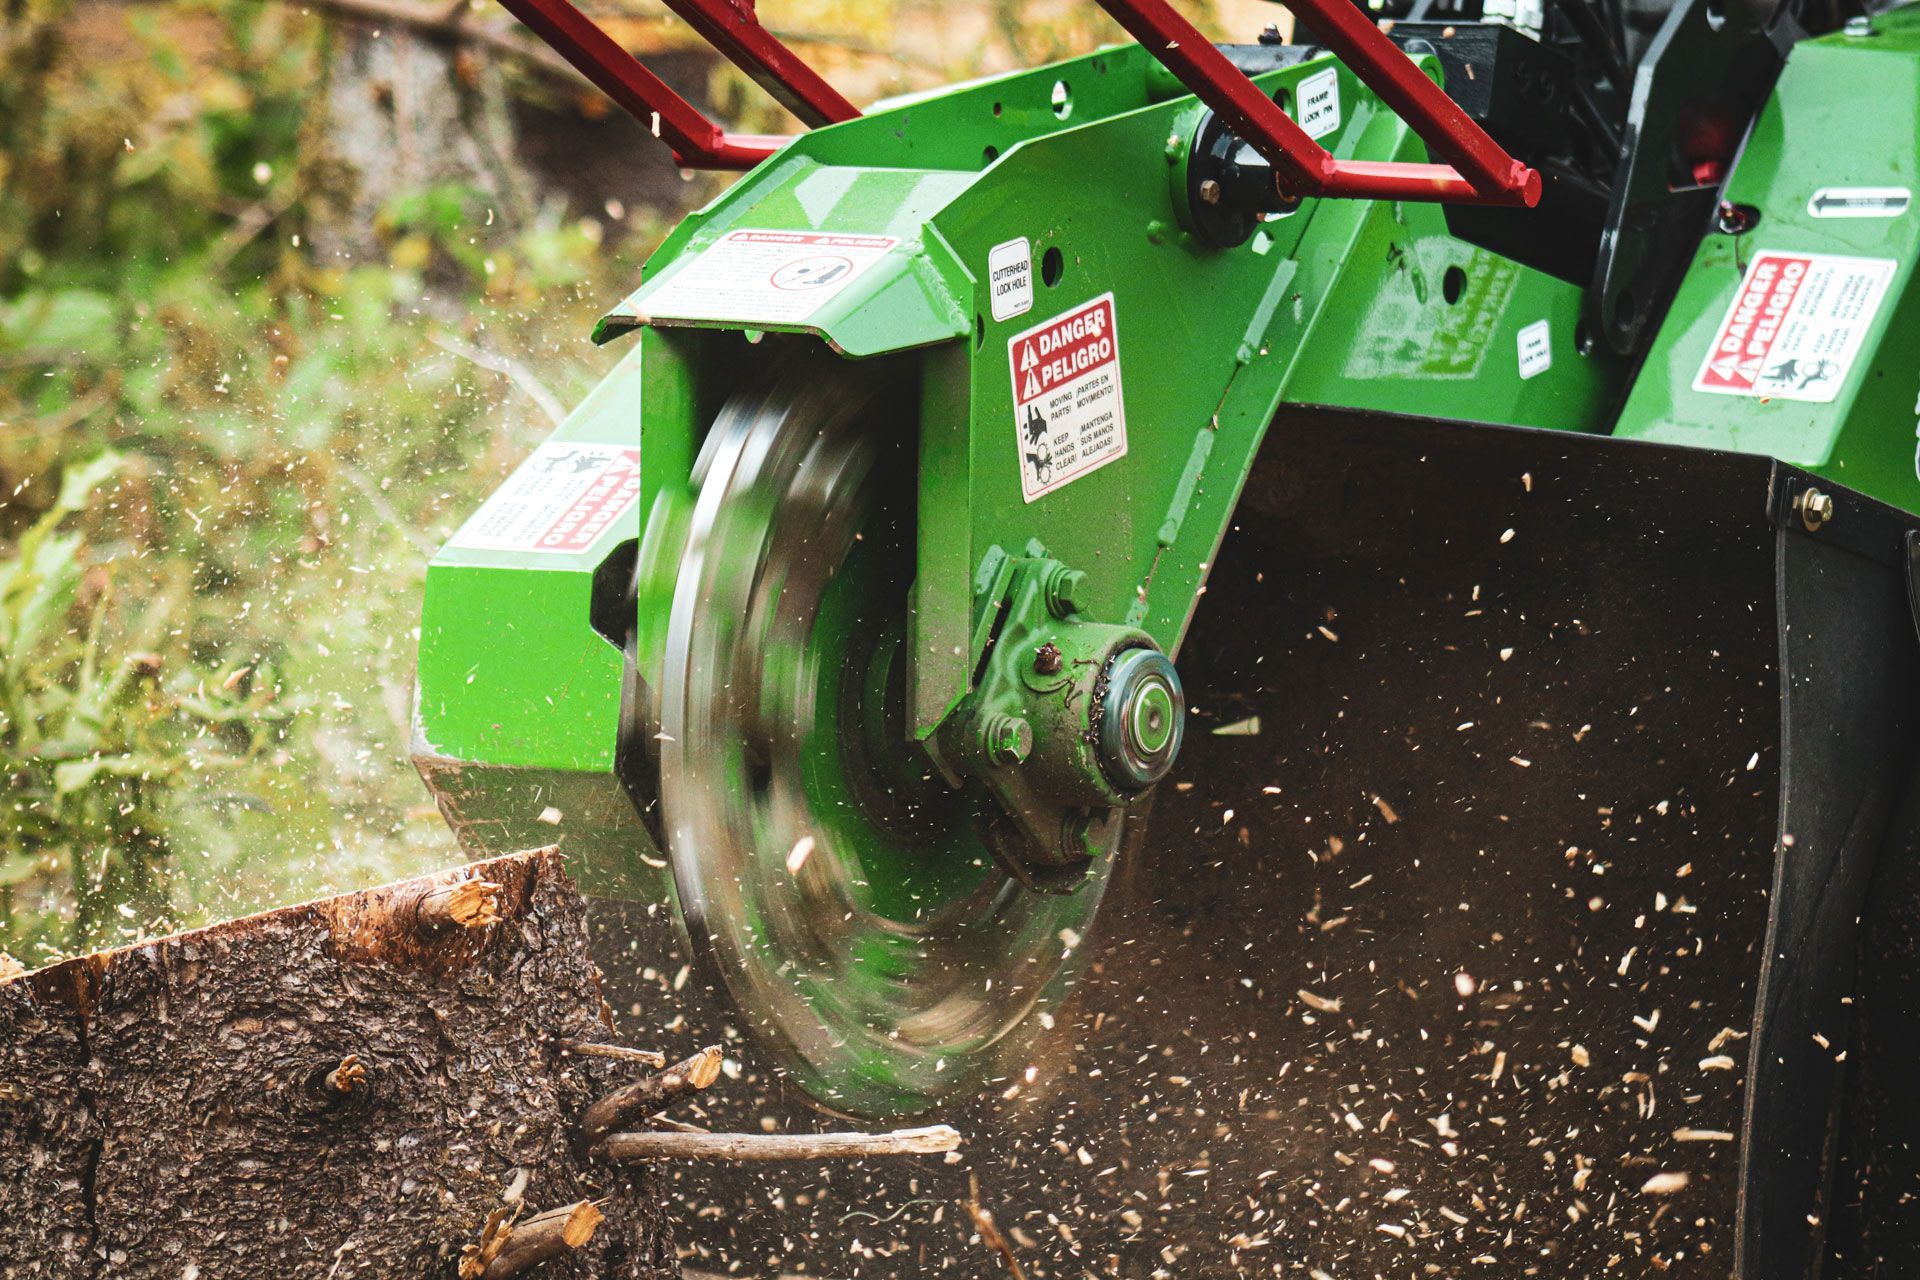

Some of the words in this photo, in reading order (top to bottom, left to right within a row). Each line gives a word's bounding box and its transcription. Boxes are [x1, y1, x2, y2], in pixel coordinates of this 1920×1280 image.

[1304, 110, 1320, 124] LOCK
[750, 234, 804, 243] DANGER
[830, 237, 889, 247] PELIGRO
[993, 260, 1028, 282] CUTTERHEAD
[996, 280, 1011, 296] LOCK
[1012, 276, 1027, 290] HOLE
[1720, 262, 1779, 353] DANGER
[1746, 261, 1805, 355] PELIGRO
[1039, 308, 1106, 356] DANGER
[1041, 337, 1111, 387] PELIGRO
[1100, 374, 1109, 384] EN
[1049, 391, 1073, 408] MOVING
[1076, 385, 1114, 408] MOVIMIENTO!
[1050, 405, 1072, 421] PARTS!
[1053, 432, 1069, 447] KEEP
[1080, 434, 1092, 446] SUS
[1093, 423, 1114, 439] MANOS
[1054, 443, 1075, 459] HANDS
[1082, 436, 1113, 458] ALEJADAS!
[1056, 454, 1077, 470] CLEAR!
[543, 475, 621, 545] PELIGRO
[569, 476, 640, 545] DANGER
